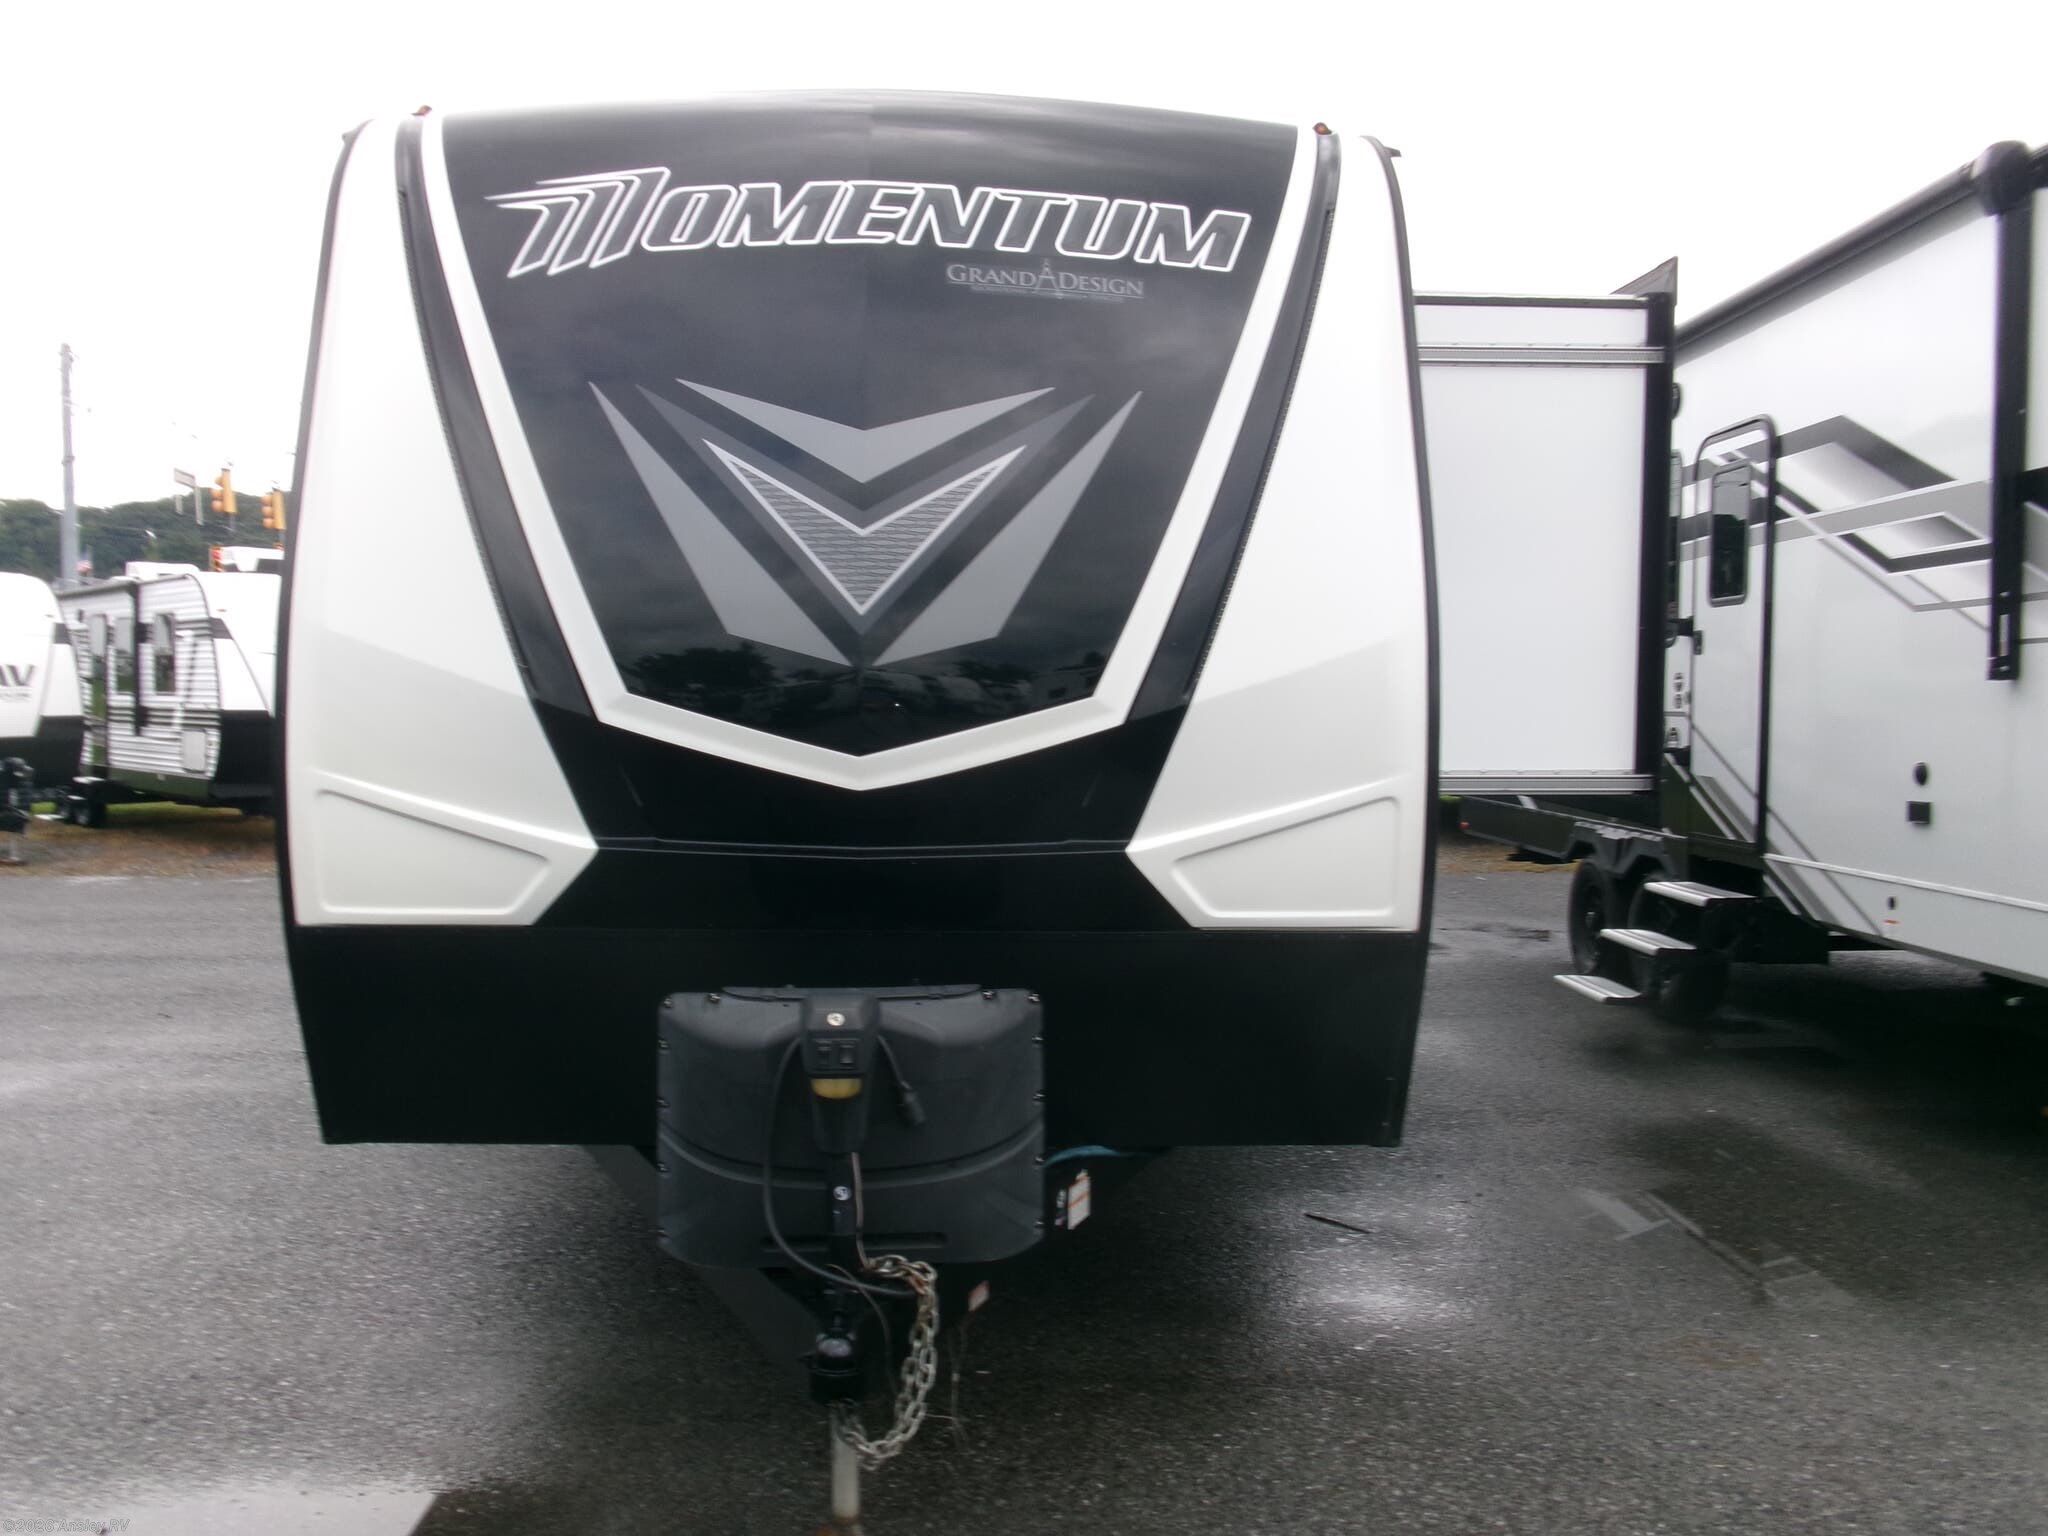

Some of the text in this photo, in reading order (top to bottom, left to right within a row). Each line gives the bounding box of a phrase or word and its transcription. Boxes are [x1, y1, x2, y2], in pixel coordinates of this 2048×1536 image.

[485, 167, 1251, 278] MOMENTUM
[947, 264, 1037, 288] GRAND
[1058, 271, 1145, 296] DESIGN
